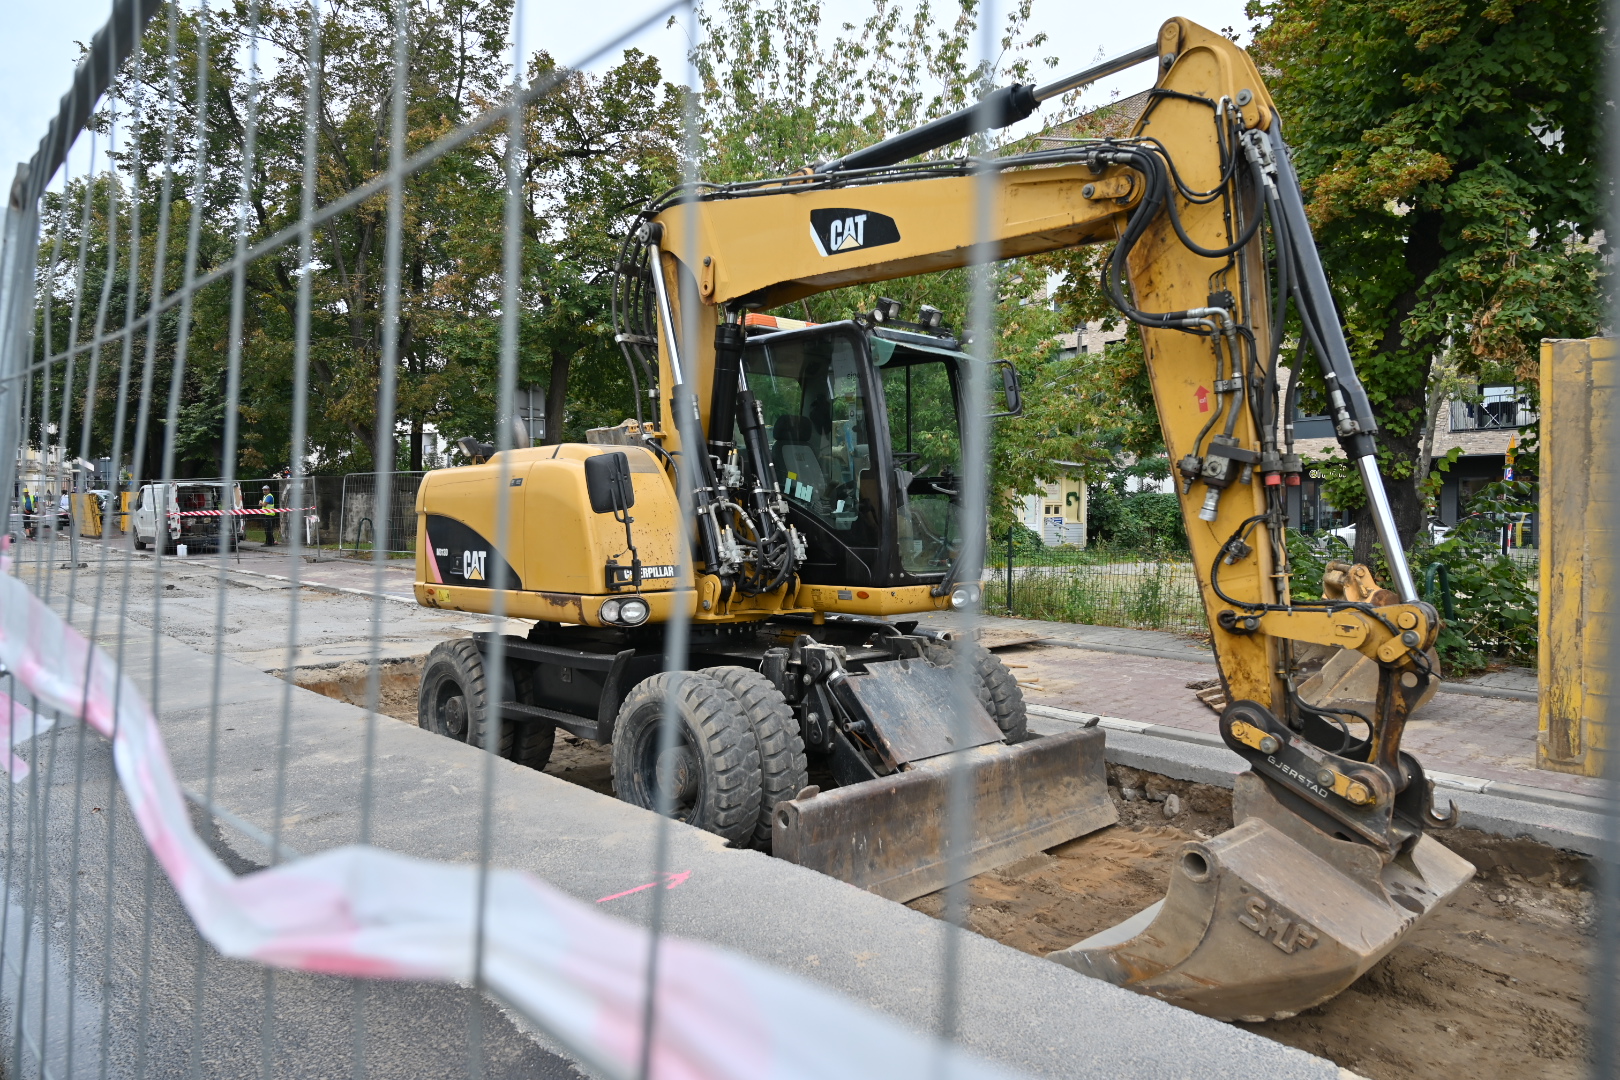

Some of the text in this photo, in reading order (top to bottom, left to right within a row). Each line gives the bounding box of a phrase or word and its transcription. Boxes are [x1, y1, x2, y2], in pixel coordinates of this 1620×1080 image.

[830, 213, 867, 251] CAT
[463, 550, 487, 580] CAT
[623, 565, 675, 580] CERPILLAR
[1267, 755, 1329, 798] GJERSTAD
